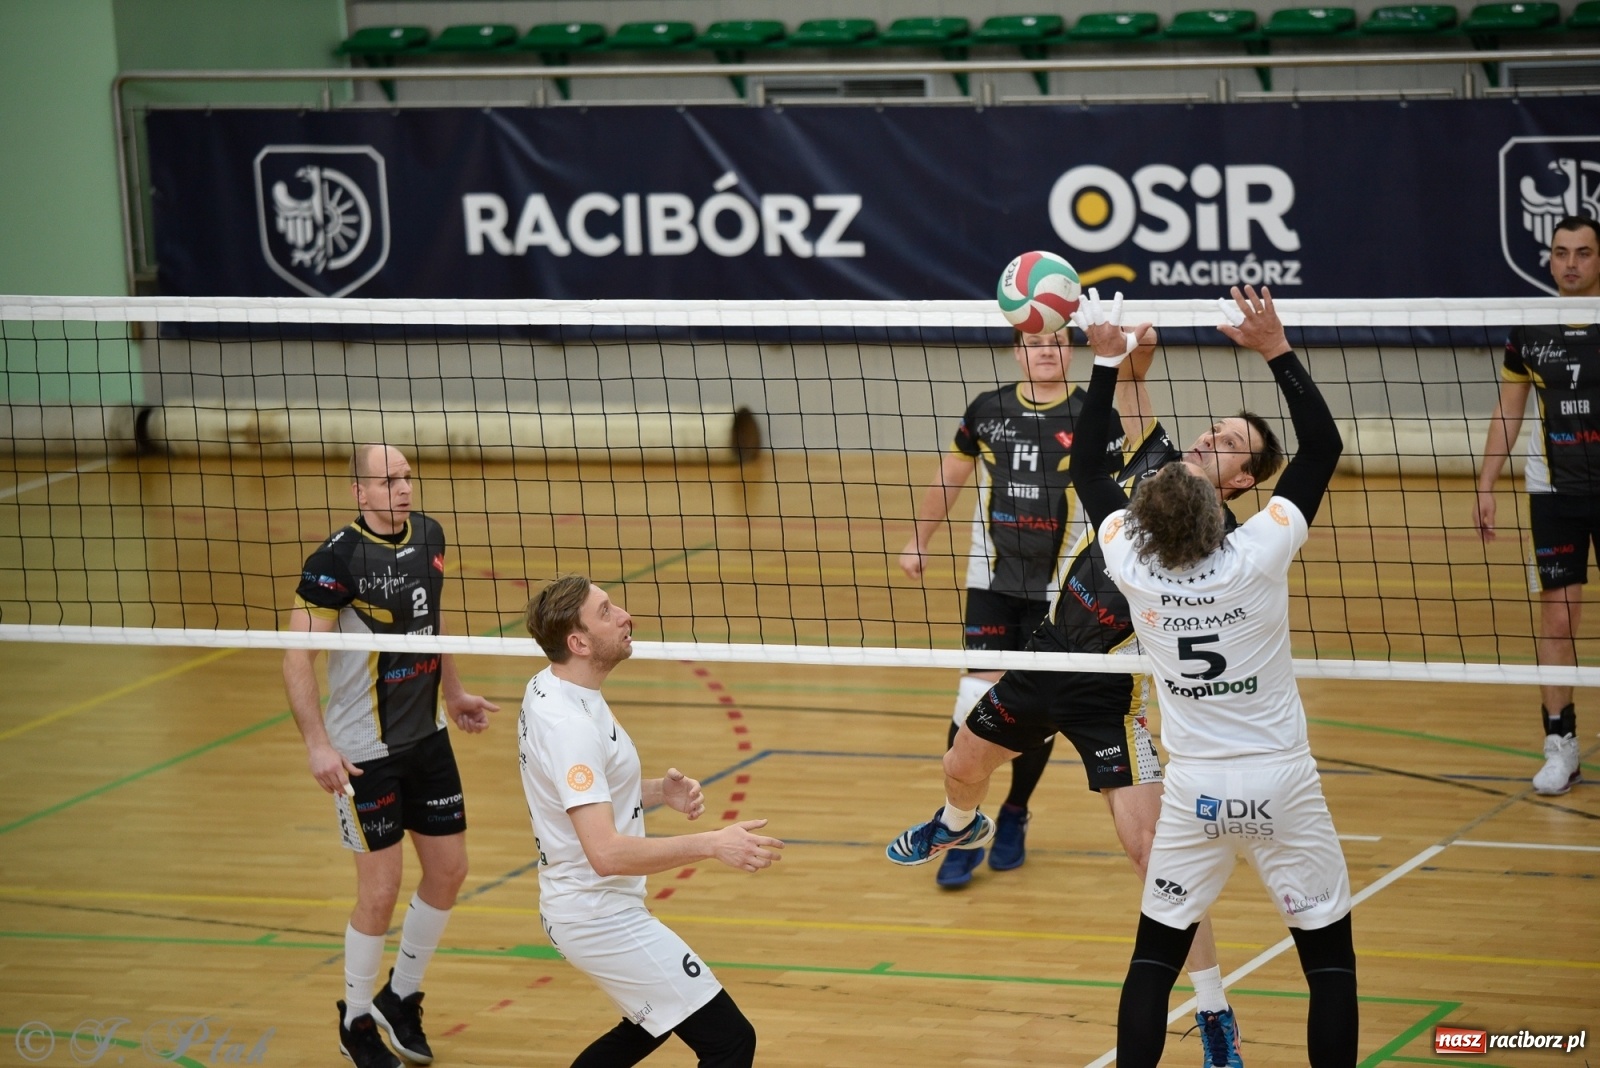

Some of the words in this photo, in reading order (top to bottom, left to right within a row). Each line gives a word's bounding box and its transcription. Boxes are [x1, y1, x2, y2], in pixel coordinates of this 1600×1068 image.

[462, 170, 866, 258] RACIBÓRZ
[1048, 163, 1301, 253] OSiR
[1149, 253, 1302, 286] RACIBÓRZ
[1566, 364, 1581, 390] 7
[1560, 400, 1590, 415] ENTER
[1012, 443, 1039, 472] 14
[1007, 481, 1040, 500] ENTER
[412, 586, 429, 618] 2
[1160, 594, 1215, 607] PYCIU
[1162, 607, 1246, 627] ZOO-MAR
[1177, 633, 1227, 681] 5
[1164, 675, 1258, 701] TropiDog
[1226, 799, 1273, 820] DK
[1203, 817, 1275, 840] glass
[682, 952, 701, 978] 6
